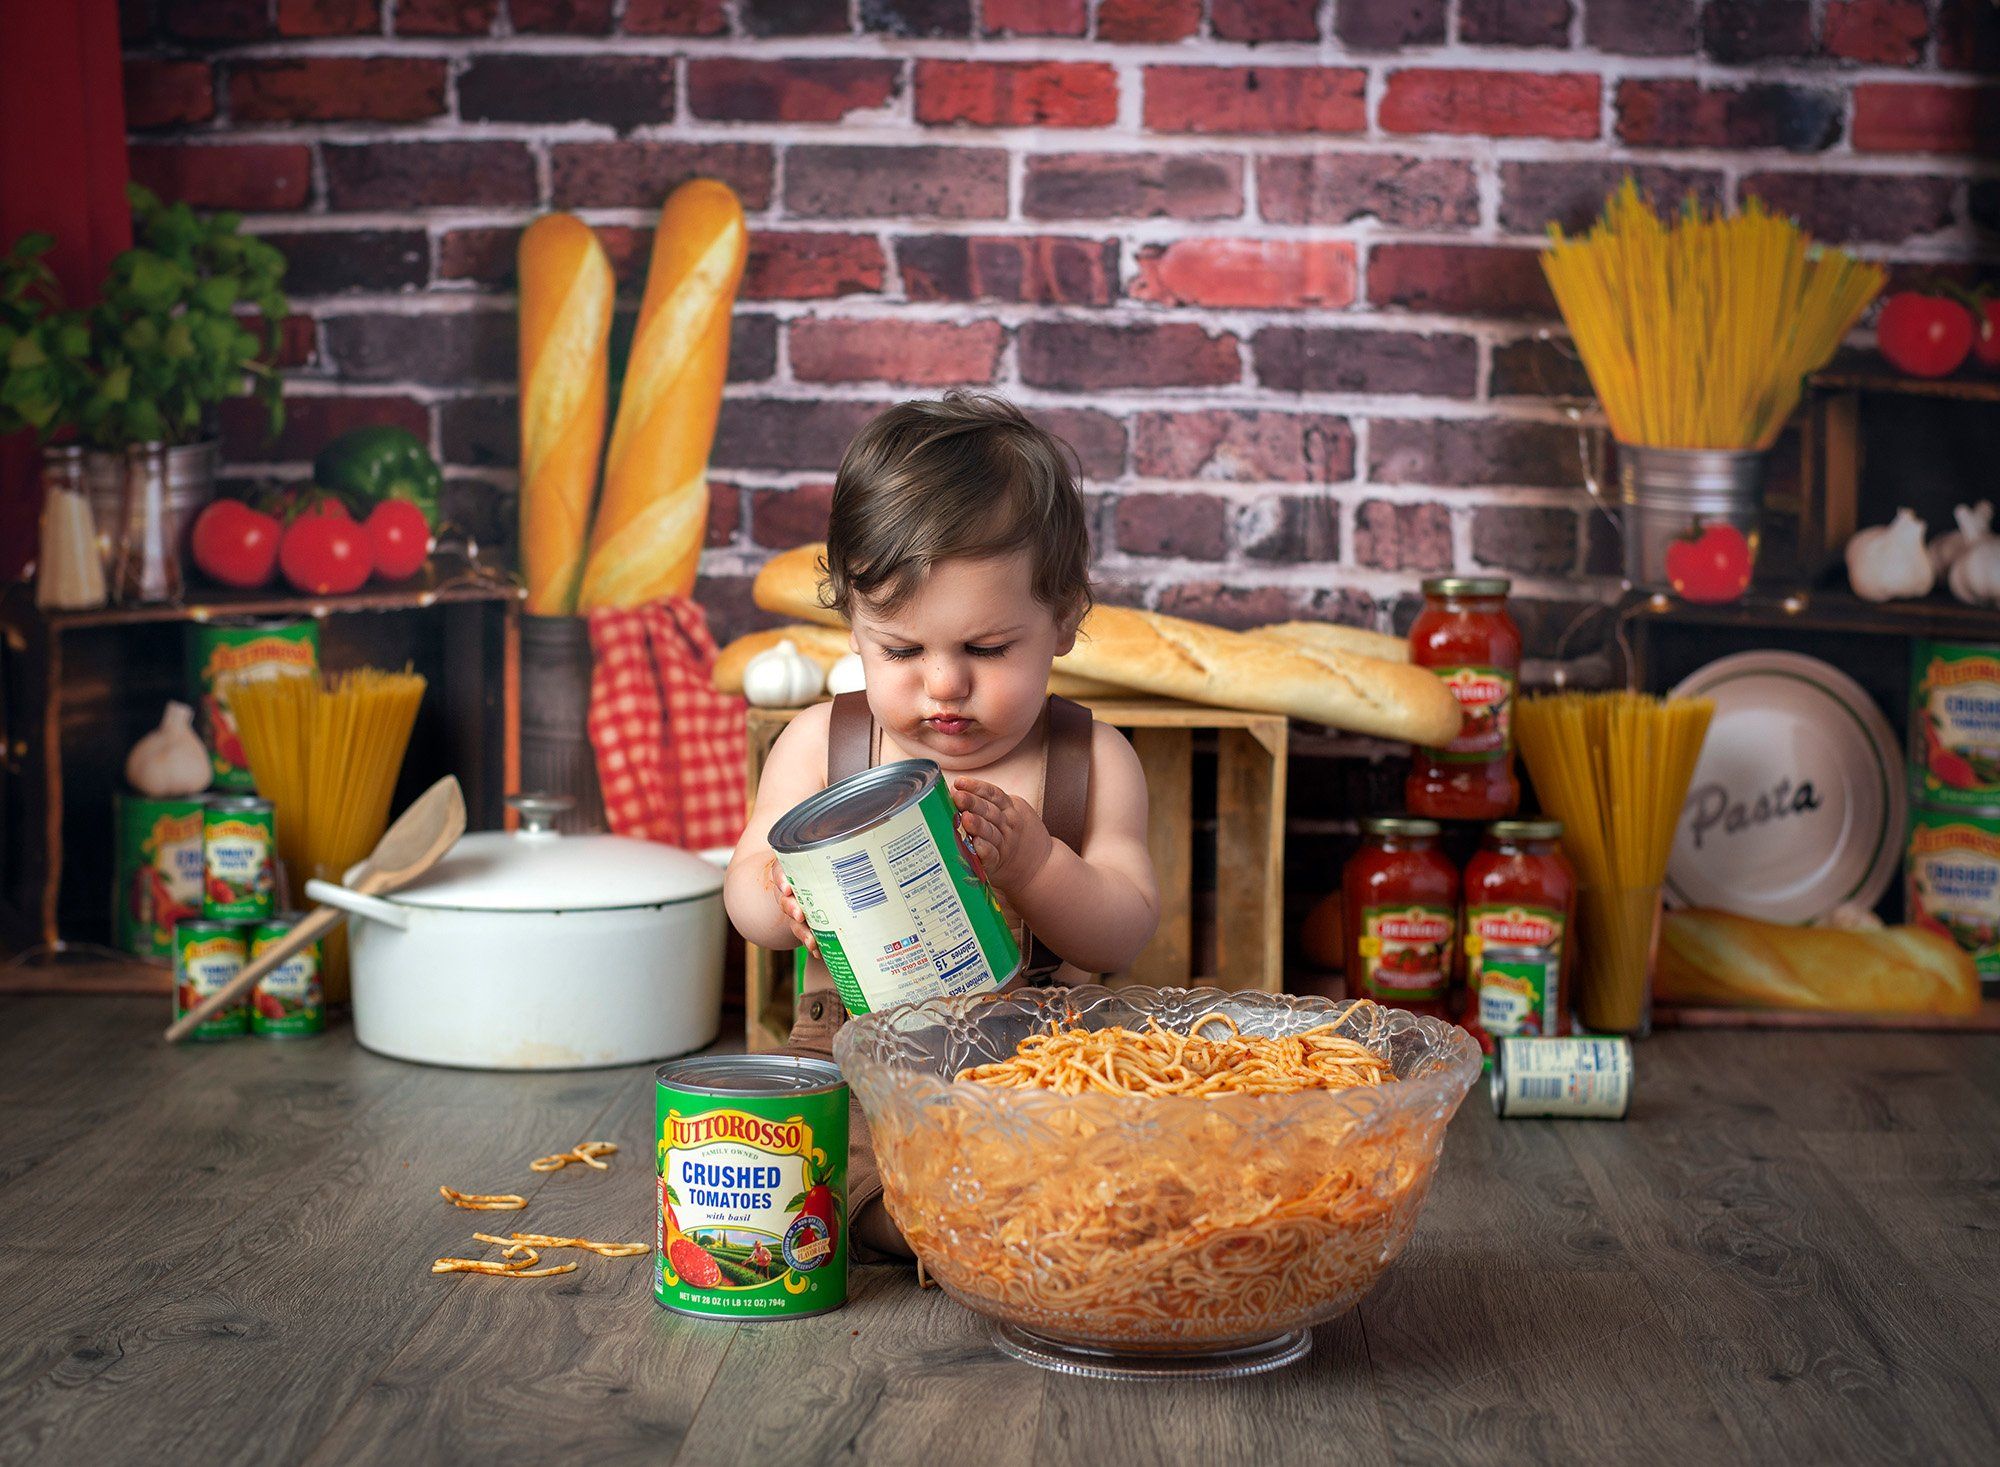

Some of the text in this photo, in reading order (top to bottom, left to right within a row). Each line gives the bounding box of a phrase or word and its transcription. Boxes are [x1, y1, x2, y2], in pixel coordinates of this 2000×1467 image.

[1686, 777, 1823, 848] Pasta
[950, 940, 976, 960] Calories
[934, 957, 948, 971] 15
[965, 970, 989, 989] Nutrition
[948, 984, 966, 997] Facts
[670, 1115, 801, 1149] TUTTOROSSO
[702, 1149, 759, 1160] FAMILY OWNED
[682, 1161, 781, 1188] CRUSHED
[688, 1188, 772, 1209] TOMATOES
[706, 1213, 751, 1221] with basil
[679, 1291, 690, 1300] NET
[691, 1294, 701, 1303] WT
[702, 1296, 710, 1304] 28
[712, 1297, 721, 1305] OZ
[722, 1298, 730, 1307] (1
[754, 1299, 767, 1308] OZ)
[768, 1298, 785, 1308] 794g
